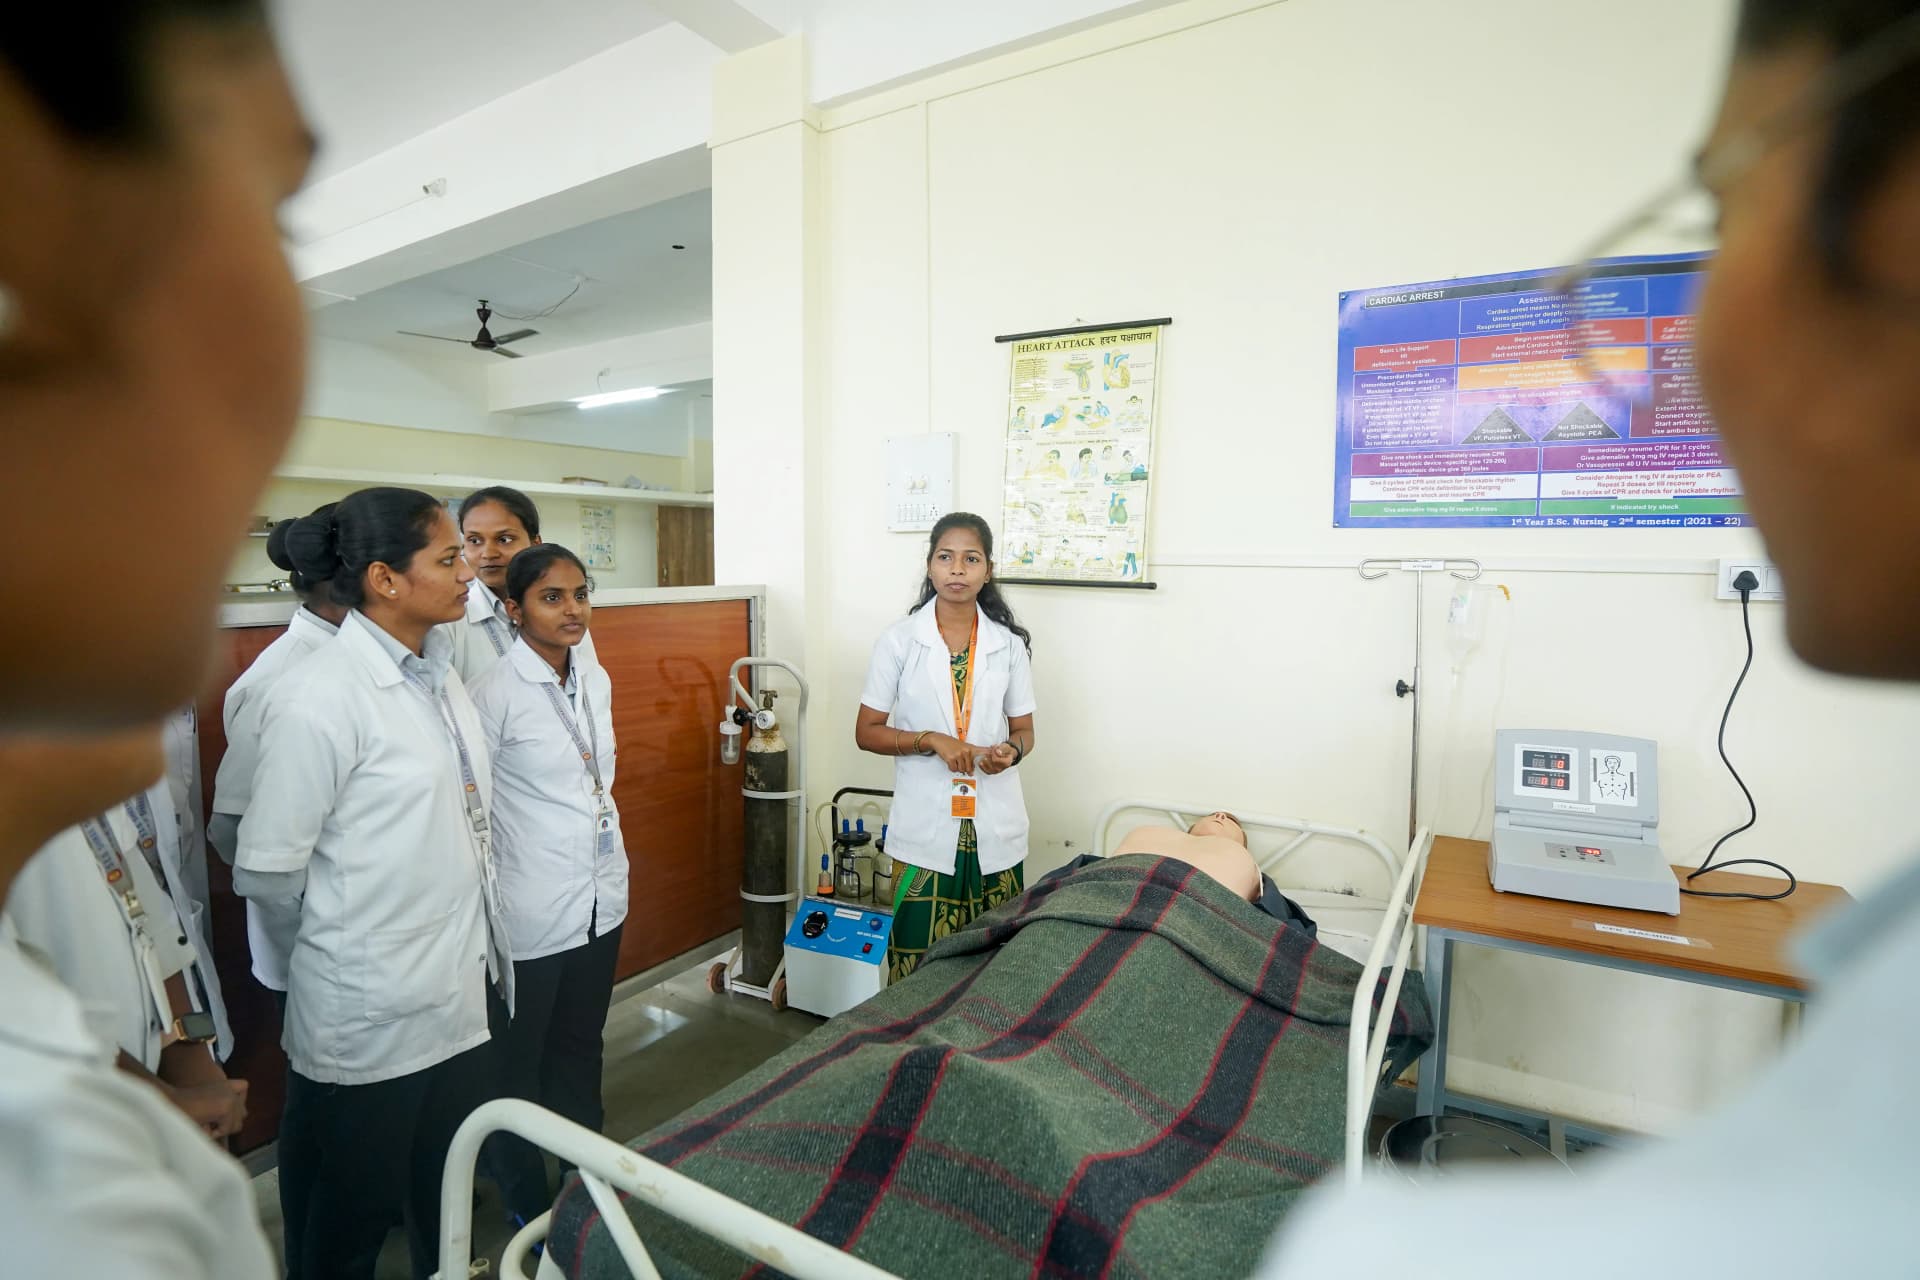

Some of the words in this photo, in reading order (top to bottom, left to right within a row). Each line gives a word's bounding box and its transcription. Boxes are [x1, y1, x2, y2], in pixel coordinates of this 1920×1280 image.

[1370, 294, 1407, 306] CARDIAC
[1410, 290, 1444, 301] ARREST
[1017, 342, 1051, 353] HEART
[1054, 337, 1096, 350] ATTACK
[1582, 488, 1602, 496] cycles
[1524, 518, 1544, 526] Year
[1573, 518, 1608, 527] Nursing
[1684, 517, 1712, 527] (2021
[1724, 517, 1740, 526] 22)
